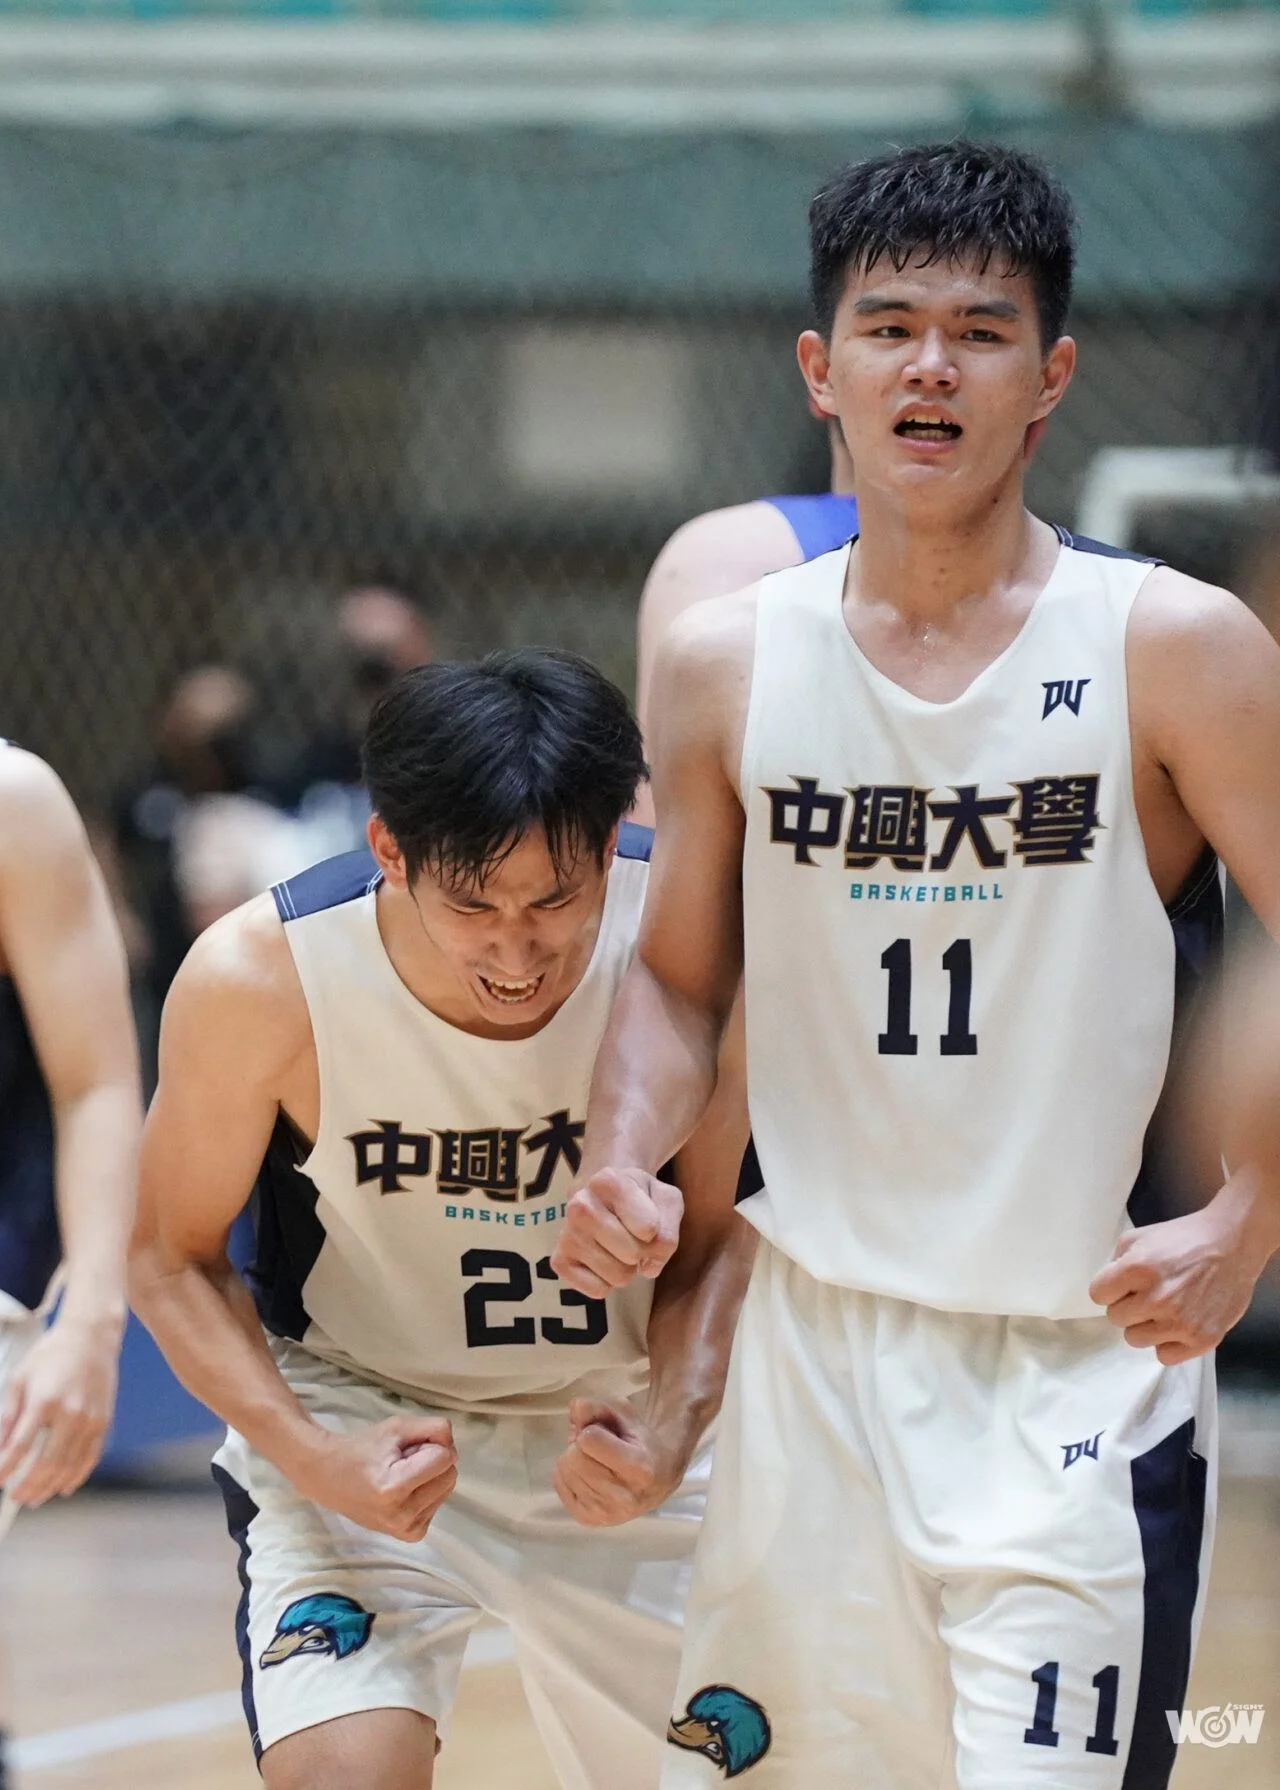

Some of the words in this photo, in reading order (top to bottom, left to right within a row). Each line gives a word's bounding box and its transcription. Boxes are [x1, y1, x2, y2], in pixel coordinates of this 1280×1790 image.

[758, 773, 1109, 873] 中興大學
[850, 883, 1004, 902] BASKETBALL
[878, 938, 978, 1056] 11
[342, 1108, 587, 1204] 中興大
[461, 1248, 609, 1348] 23
[1024, 1661, 1120, 1756] 11
